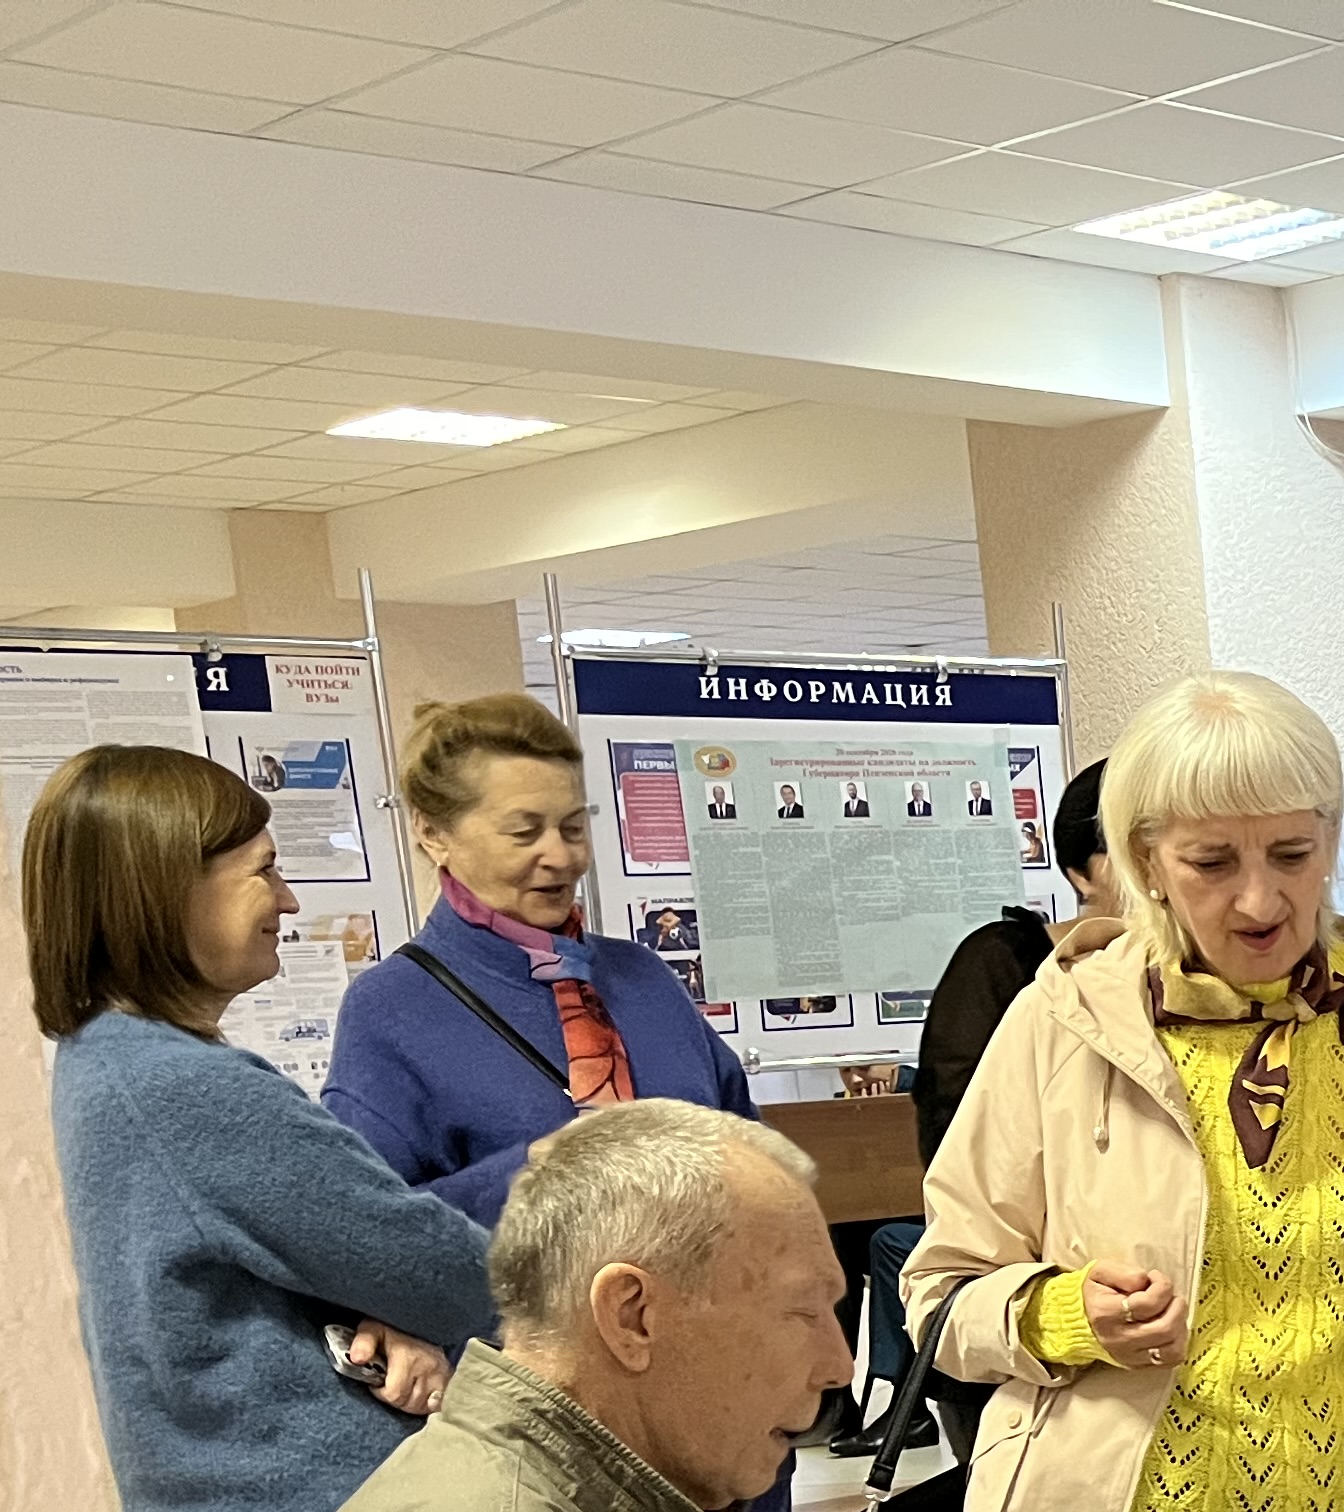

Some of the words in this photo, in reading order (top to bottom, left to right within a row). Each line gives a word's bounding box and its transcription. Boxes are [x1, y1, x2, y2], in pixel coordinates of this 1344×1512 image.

[205, 666, 230, 692] Я
[275, 663, 311, 676] КУДА
[314, 664, 361, 677] ПОЙТИ
[698, 676, 953, 709] ИНФОРМАЦИЯ
[633, 759, 675, 770] ПЕРВЫ
